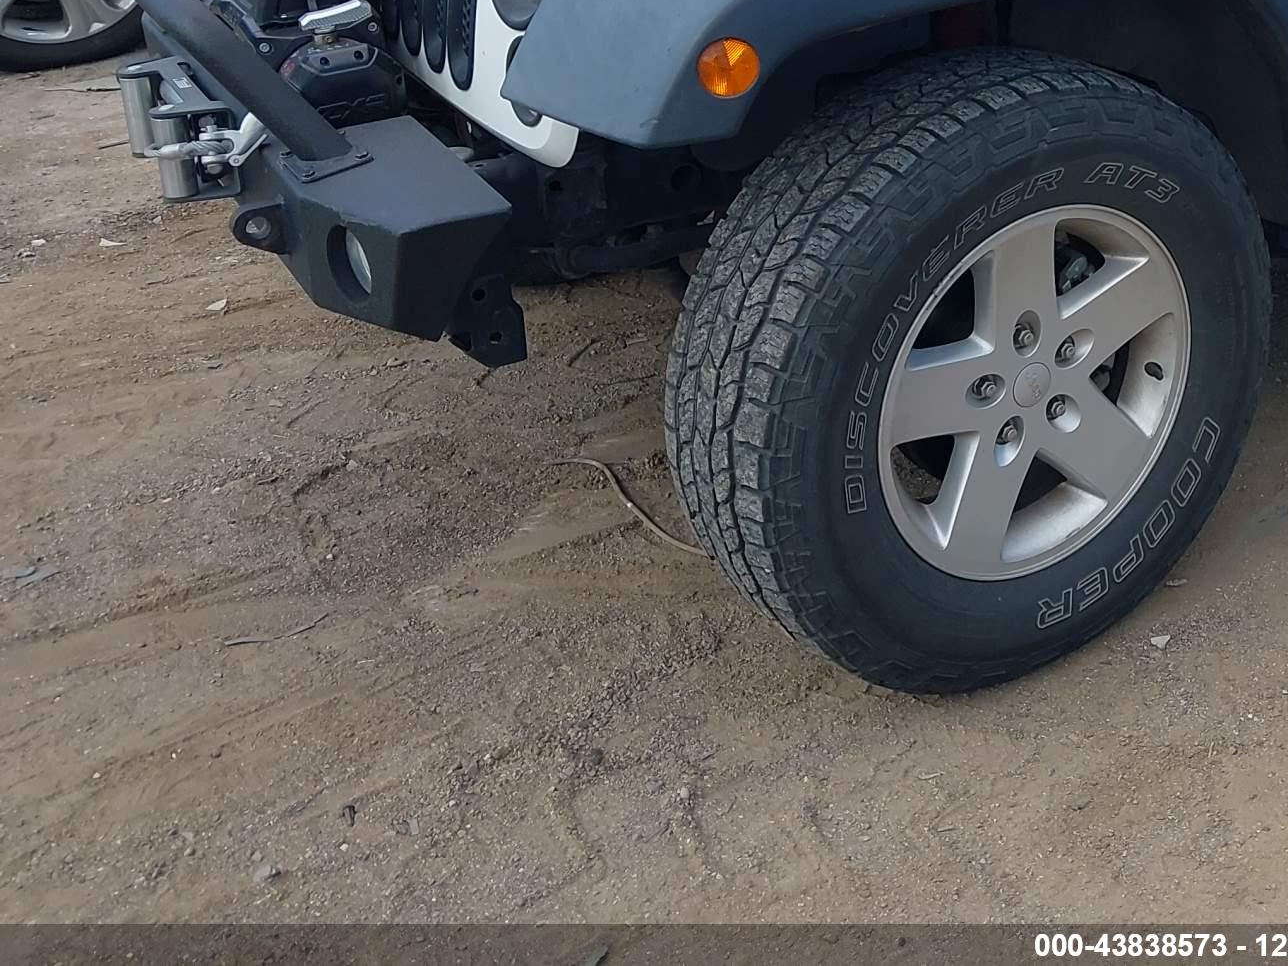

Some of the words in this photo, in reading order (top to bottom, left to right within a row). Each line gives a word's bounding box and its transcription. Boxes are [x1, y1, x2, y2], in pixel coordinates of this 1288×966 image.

[844, 167, 1066, 515] DISCOVERER
[1083, 161, 1182, 204] AT3
[1036, 416, 1222, 629] COOPER
